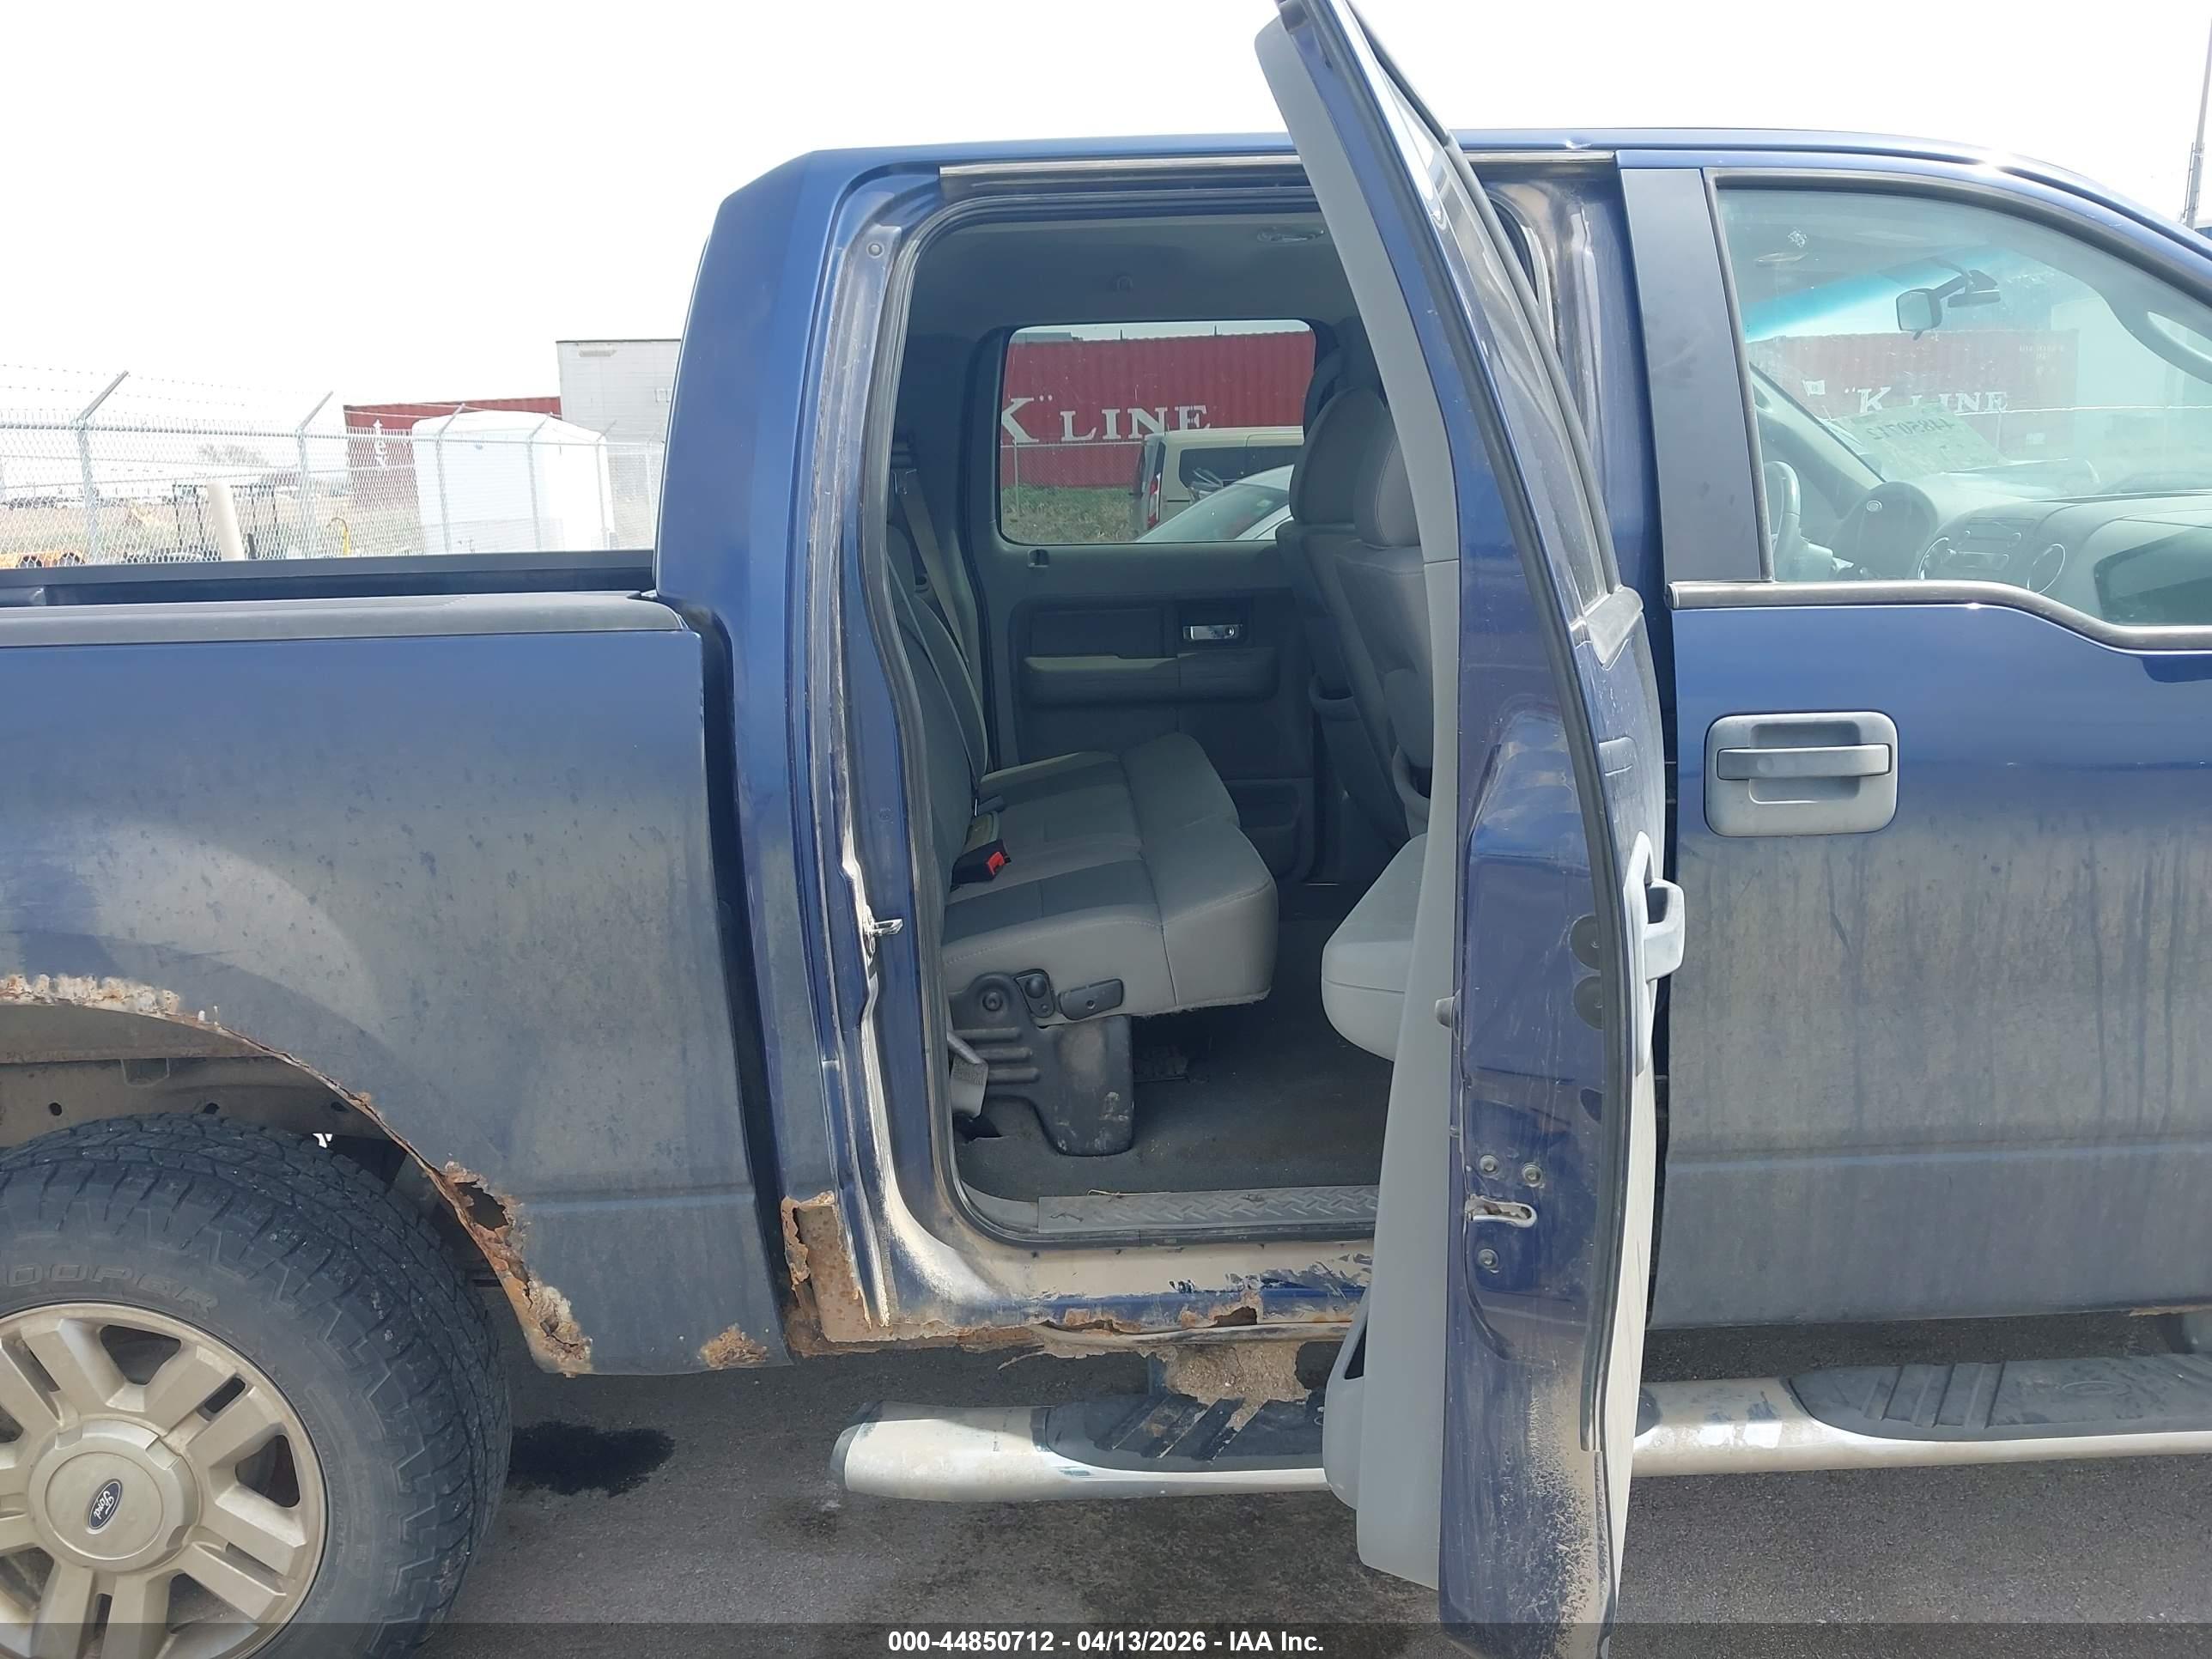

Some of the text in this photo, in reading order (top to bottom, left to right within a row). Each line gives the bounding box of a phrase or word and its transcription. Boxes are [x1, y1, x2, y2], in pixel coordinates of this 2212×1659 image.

[1059, 404, 1212, 442] LINE
[2, 1263, 220, 1320] OOPER
[93, 1490, 115, 1520] Ford
